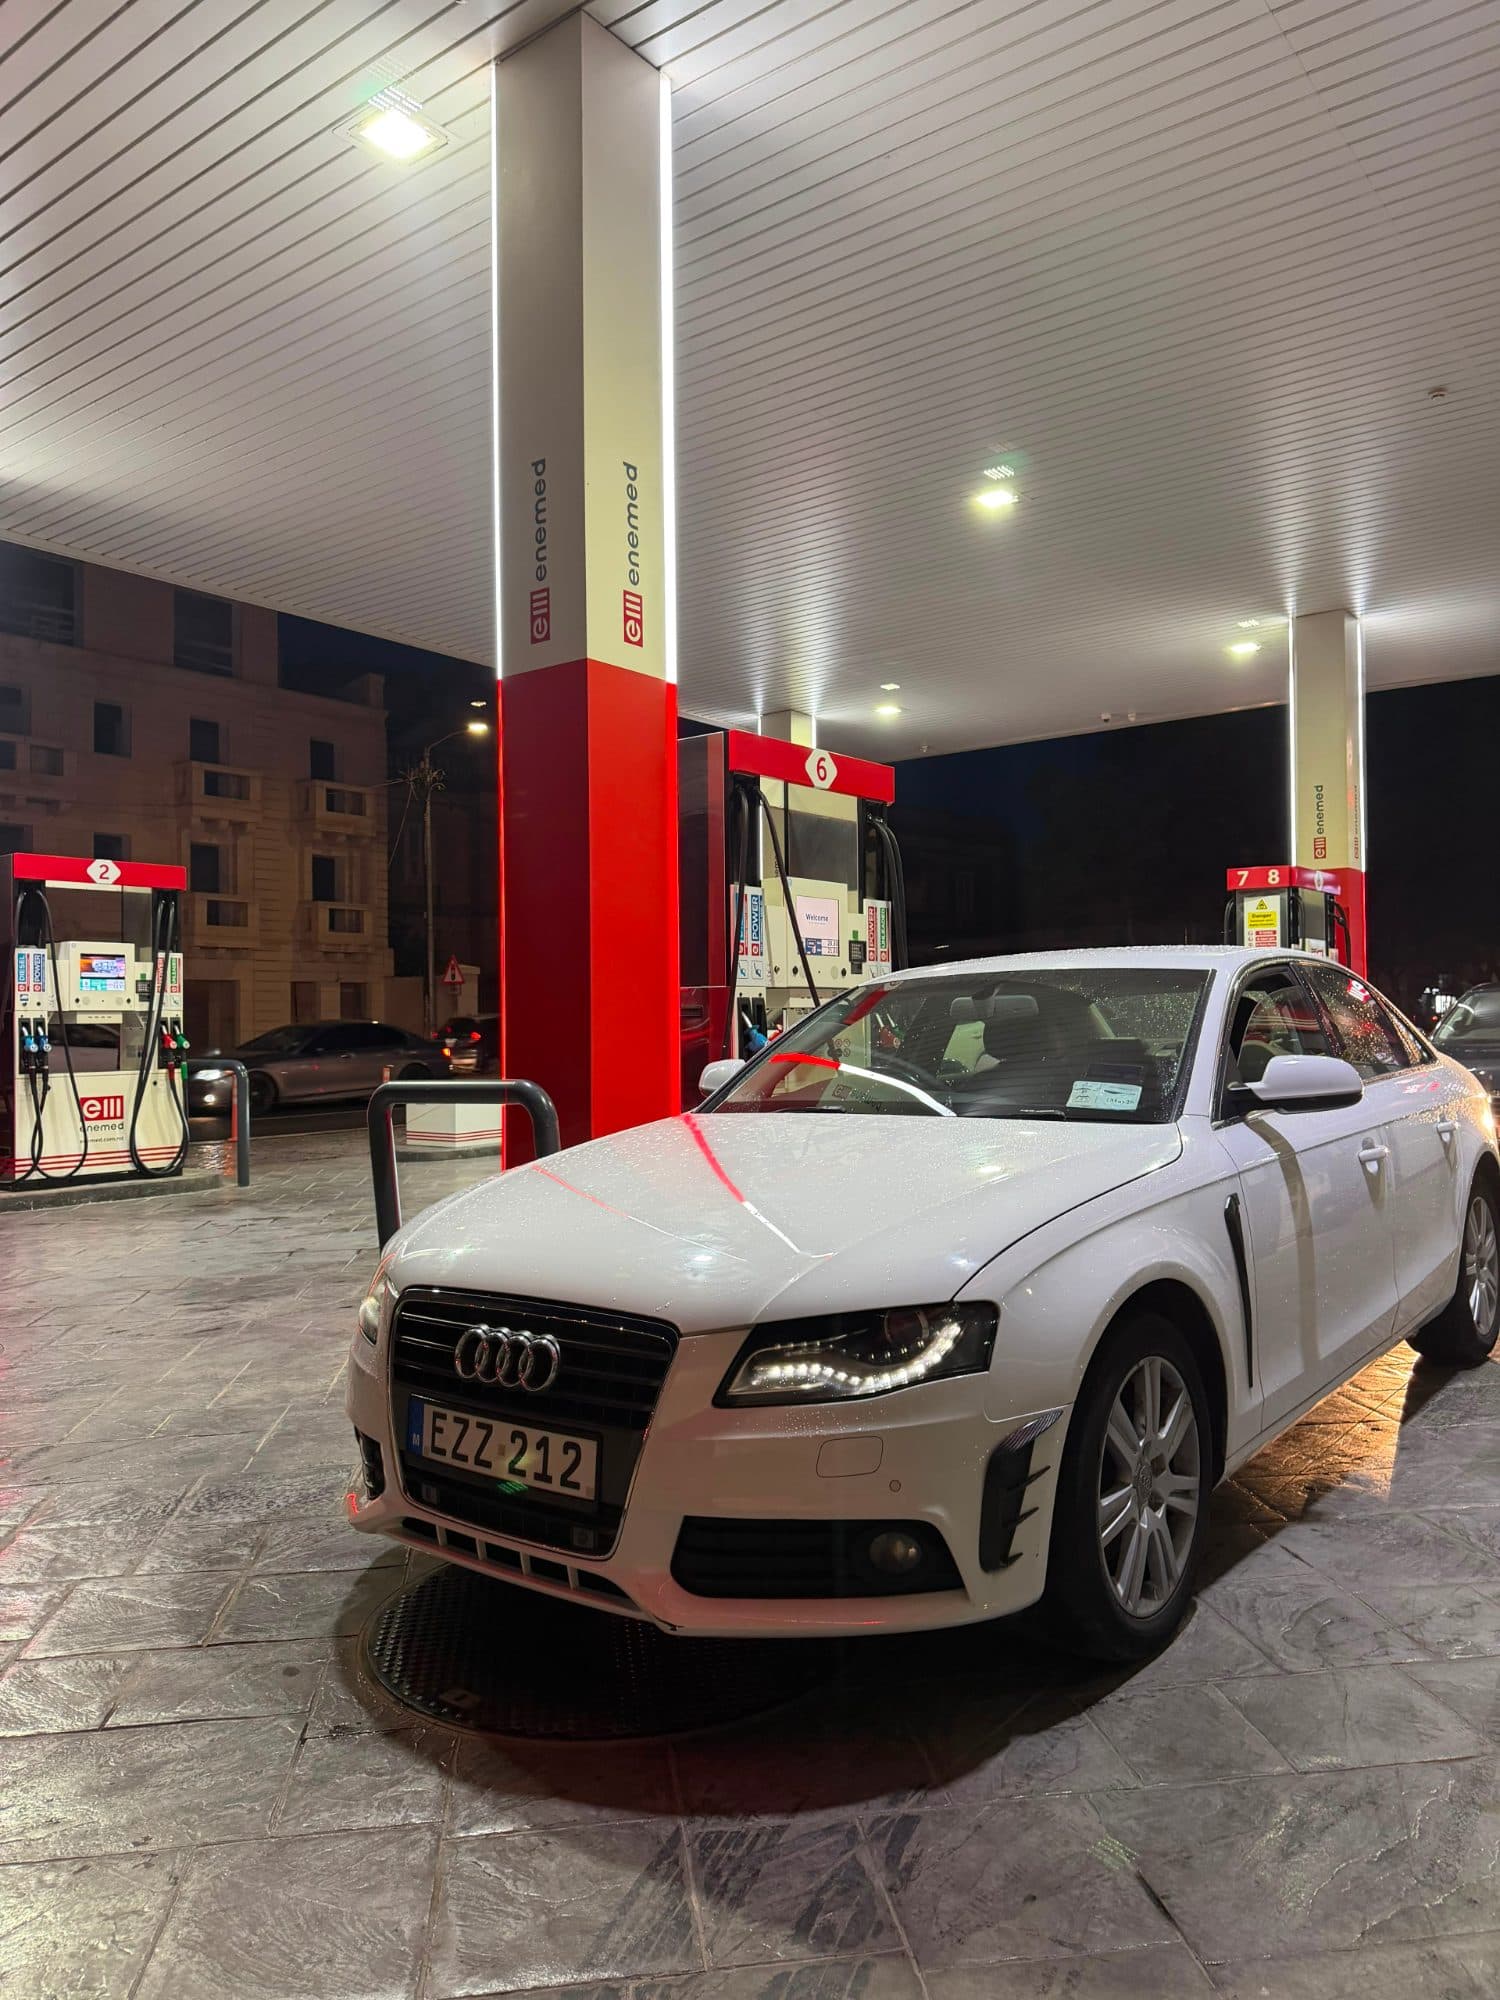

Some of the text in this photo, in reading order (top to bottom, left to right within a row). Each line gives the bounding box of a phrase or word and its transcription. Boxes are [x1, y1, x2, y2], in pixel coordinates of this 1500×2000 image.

[531, 458, 547, 582] enemed
[623, 461, 640, 586] enemed
[816, 757, 828, 781] 6
[1314, 784, 1325, 835] enemed
[98, 864, 110, 880] 2
[1236, 868, 1280, 887] 7 8
[805, 913, 829, 923] Welcome
[411, 1411, 583, 1491] M EZZ 212
